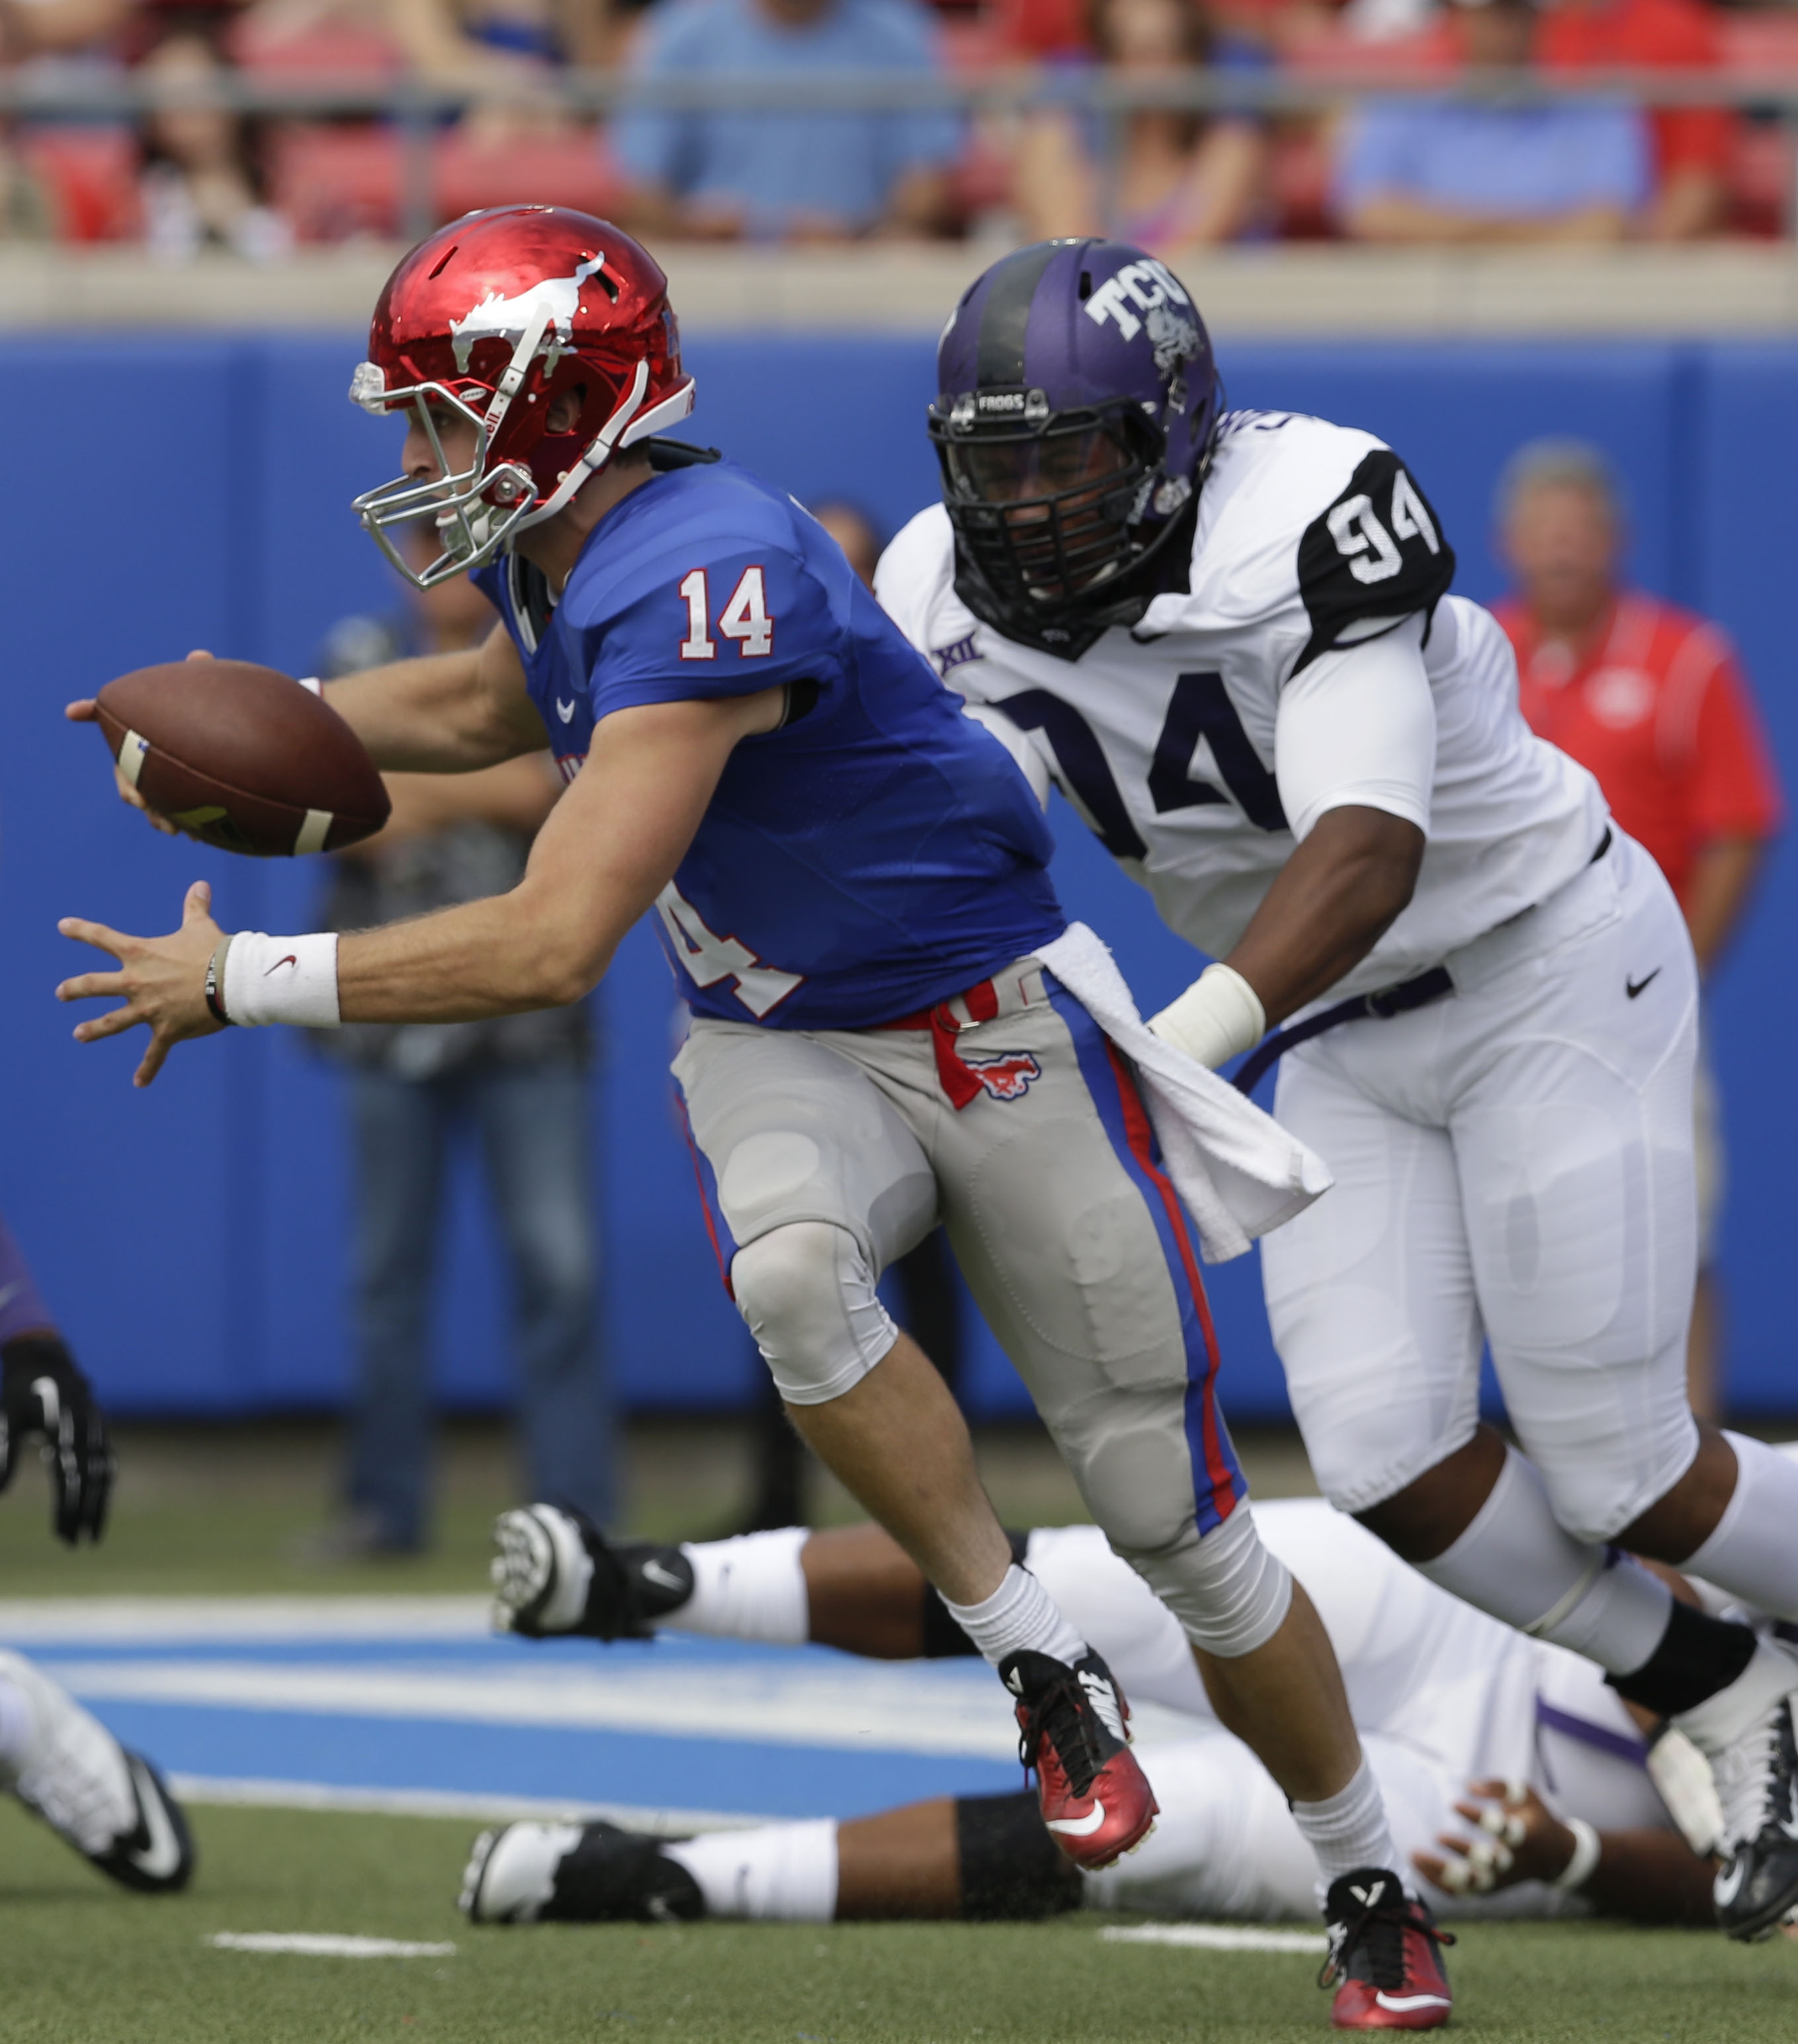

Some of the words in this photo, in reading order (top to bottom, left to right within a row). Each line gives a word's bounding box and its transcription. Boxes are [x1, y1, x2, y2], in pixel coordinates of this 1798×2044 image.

[1085, 259, 1189, 342] TCU
[979, 394, 1025, 411] FROGS
[1326, 468, 1440, 584] 94
[679, 565, 775, 660] 14
[931, 631, 985, 676] XII
[654, 879, 808, 1021] 4
